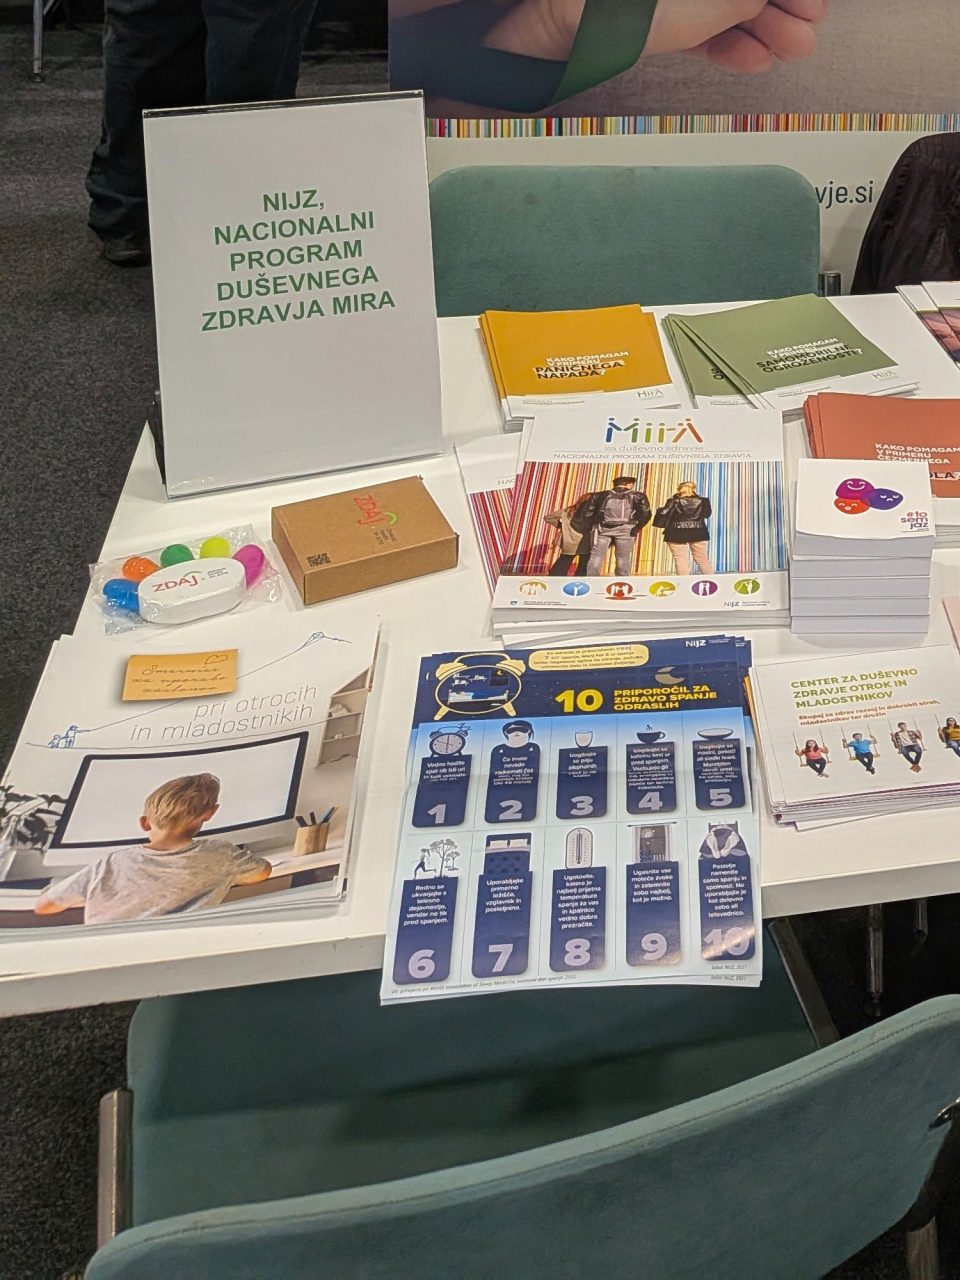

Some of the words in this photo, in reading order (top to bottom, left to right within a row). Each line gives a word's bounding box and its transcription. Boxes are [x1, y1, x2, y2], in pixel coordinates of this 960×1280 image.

[263, 189, 324, 212] NIJZ,
[214, 211, 374, 245] NACIONALNI
[229, 239, 363, 271] PROGRAM
[217, 265, 379, 301] DUŠEVNEGA
[202, 299, 325, 332] ZDRAVJA
[332, 290, 396, 315] MIRA
[576, 352, 629, 360] POMAGAM
[756, 345, 851, 368] SAMOMORILNE
[766, 347, 792, 355] KAKO
[793, 338, 839, 349] POMAGAM
[537, 370, 605, 379] NAPADA?
[885, 450, 931, 458] PRIMERU
[686, 639, 706, 648] NIJZ
[791, 677, 839, 689] CENTER
[842, 675, 858, 684] ZA
[860, 668, 918, 682] DUŠEVNO
[613, 685, 690, 696] PRIPOROČIL
[614, 694, 666, 704] ZDRAVO
[670, 692, 717, 701] SPANJE
[793, 686, 847, 699] ZDRAVJE
[849, 680, 891, 693] OTROK
[894, 679, 907, 687] IN
[194, 701, 226, 721] pri
[236, 685, 318, 714] otrocih
[554, 688, 604, 713] 10
[613, 701, 679, 711] ODRASLIH
[796, 690, 893, 709] MLADOSTNIKOV
[130, 724, 152, 741] in
[161, 705, 314, 739] mladostnikih
[570, 796, 594, 816] 3
[638, 792, 663, 810] 4
[709, 788, 733, 807] 5
[427, 804, 446, 824] 1
[499, 800, 522, 820] 2
[564, 938, 591, 966] 8
[641, 933, 667, 960] 9
[703, 927, 750, 957] 10
[408, 949, 435, 979] 6
[488, 944, 513, 973] 7
